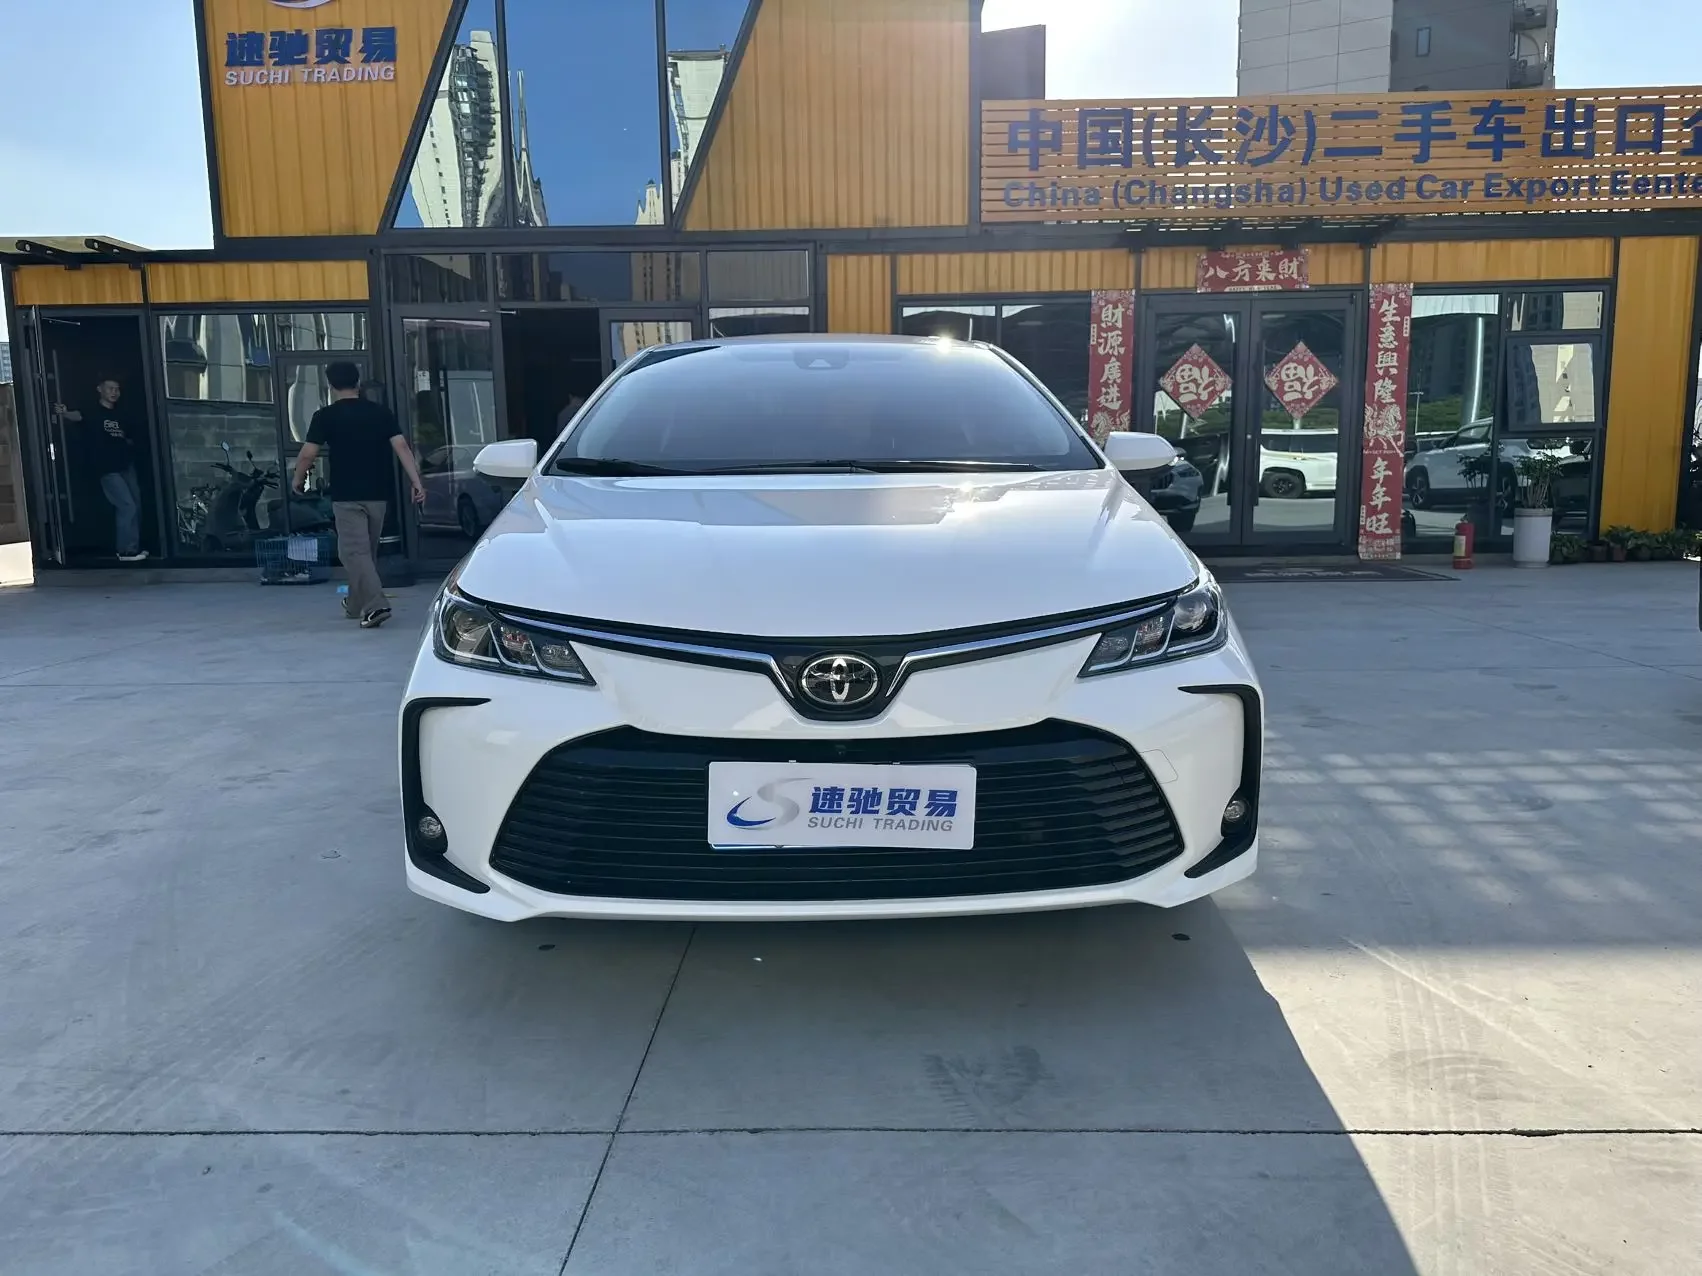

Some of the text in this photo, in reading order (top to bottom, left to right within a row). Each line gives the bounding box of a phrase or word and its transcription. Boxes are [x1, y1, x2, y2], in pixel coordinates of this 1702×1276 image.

[225, 26, 397, 67] 速驰贸易
[225, 66, 395, 86] SUCHI TRADING
[1003, 180, 1100, 208] China
[1113, 179, 1306, 209] (Changsha)
[1320, 175, 1406, 201] Used
[1416, 173, 1474, 200] Car
[1484, 171, 1600, 204] Export
[808, 786, 959, 818] 速驰贸易
[807, 816, 954, 832] SUCHI TRADING
